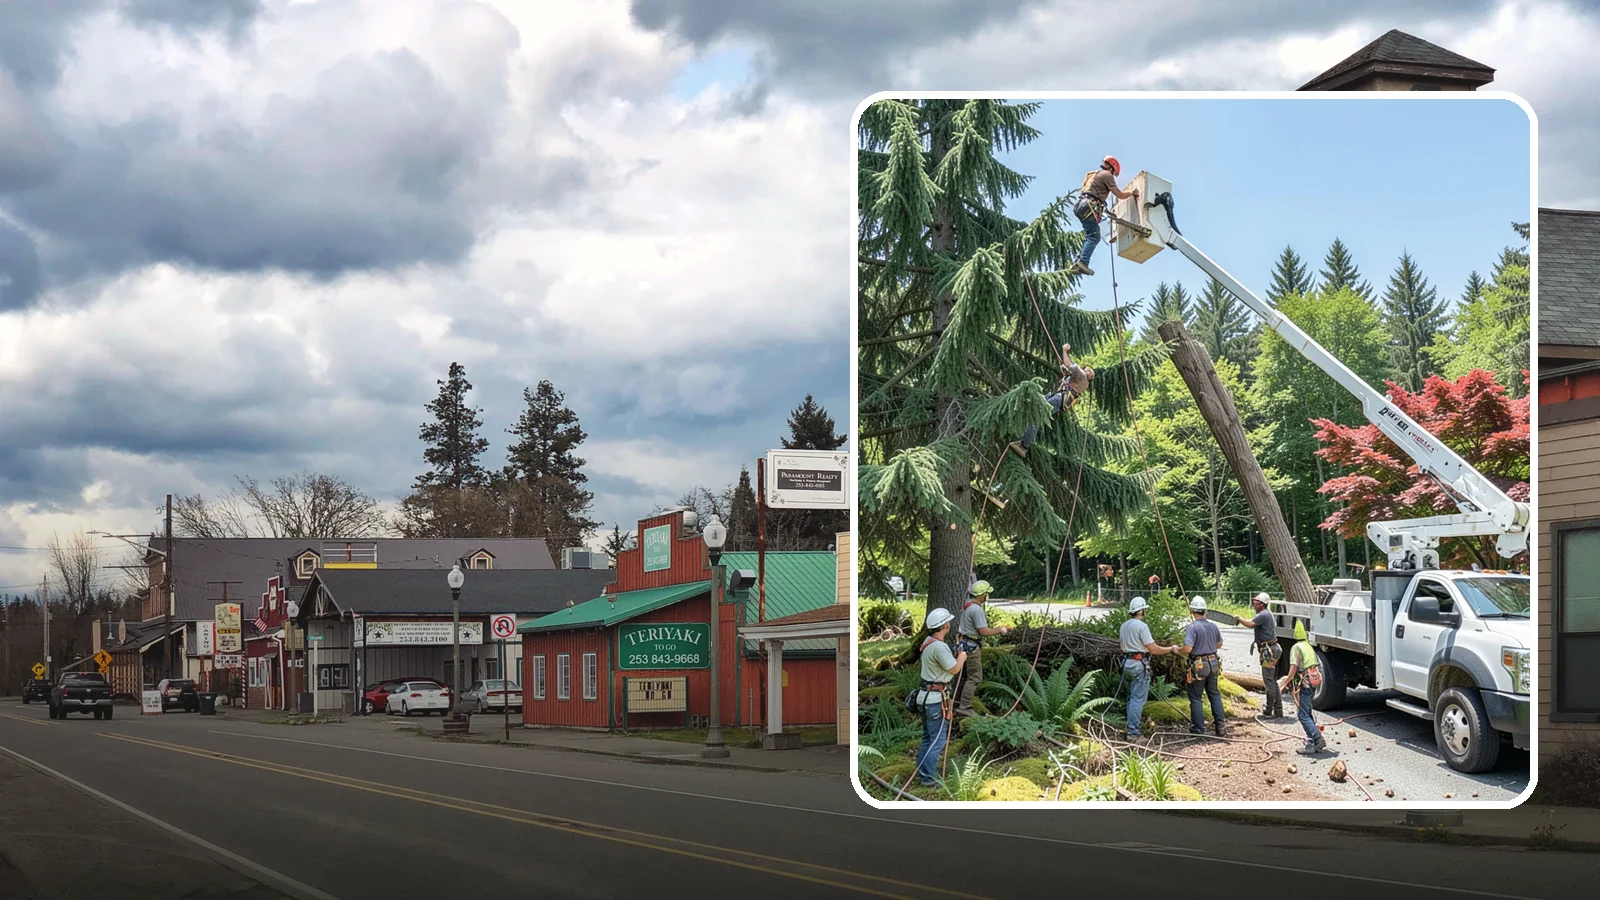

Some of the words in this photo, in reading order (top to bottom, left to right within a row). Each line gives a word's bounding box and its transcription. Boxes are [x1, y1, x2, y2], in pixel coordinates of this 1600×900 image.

[625, 628, 702, 646] TERIYAKI
[629, 654, 648, 664] 253
[652, 654, 700, 664] 843-9668
[639, 682, 672, 690] TERIYAKI
